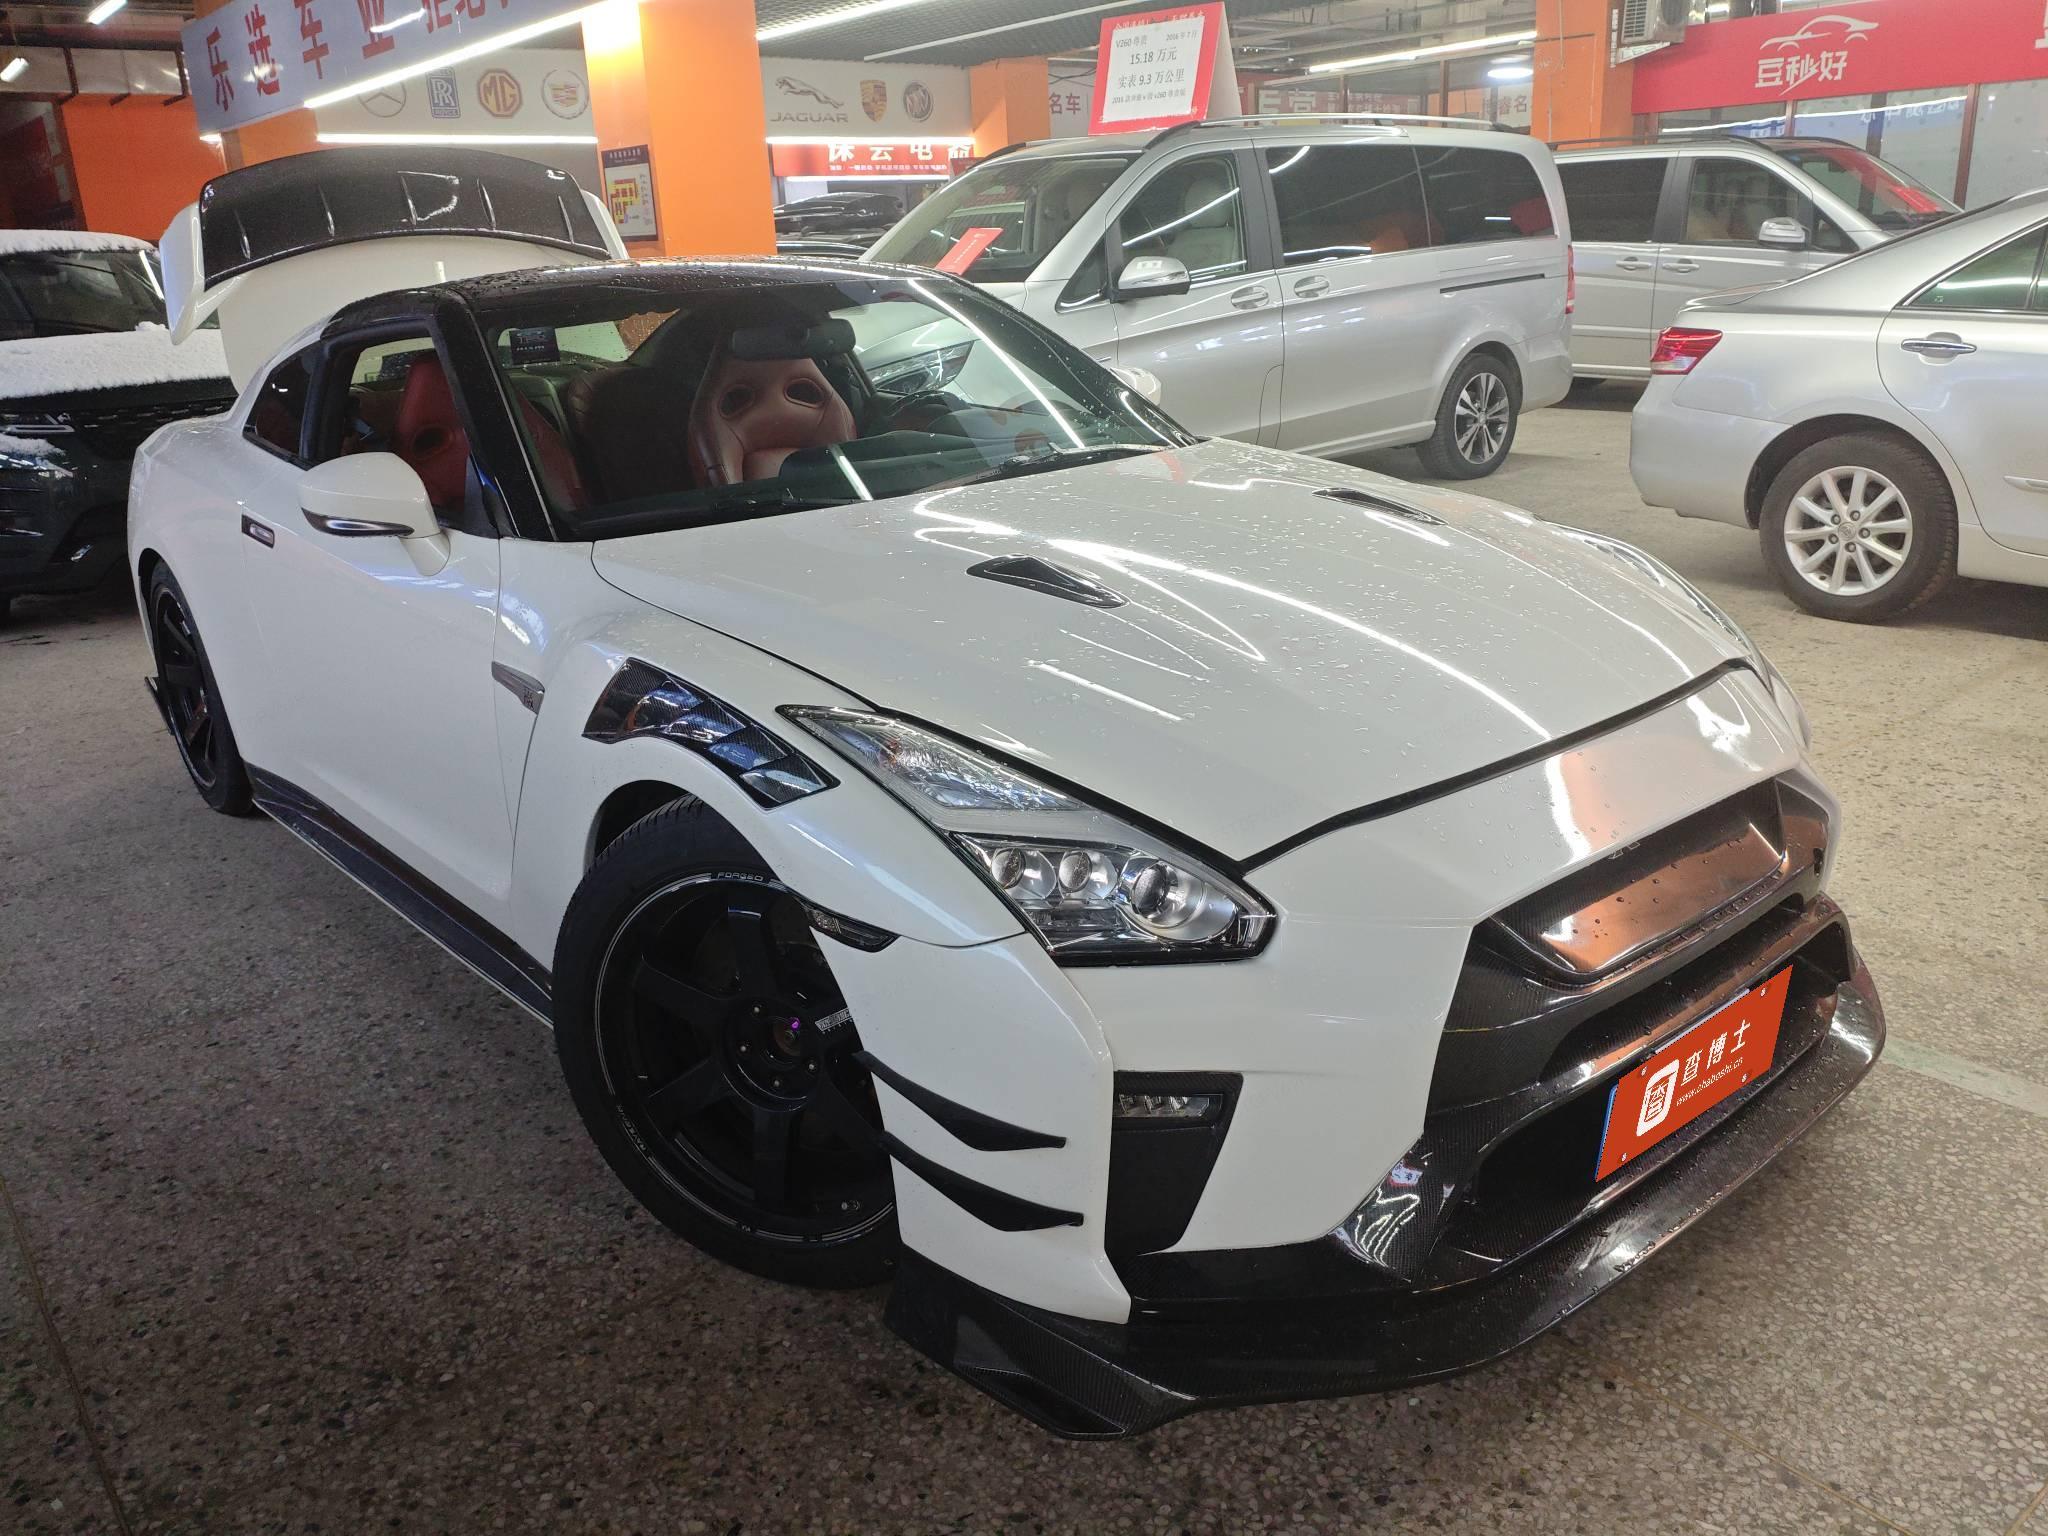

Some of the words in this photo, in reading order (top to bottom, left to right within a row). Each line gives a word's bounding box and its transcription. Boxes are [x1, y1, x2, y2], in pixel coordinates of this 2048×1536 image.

[1130, 51, 1154, 65] 15.18
[1156, 47, 1178, 63] 万元
[1118, 74, 1137, 89] 实表
[1139, 75, 1152, 86] 9.3
[1155, 68, 1185, 84] 万公里
[484, 75, 517, 112] MG
[1049, 92, 1081, 115] 名车
[770, 112, 849, 123] JAGUAR
